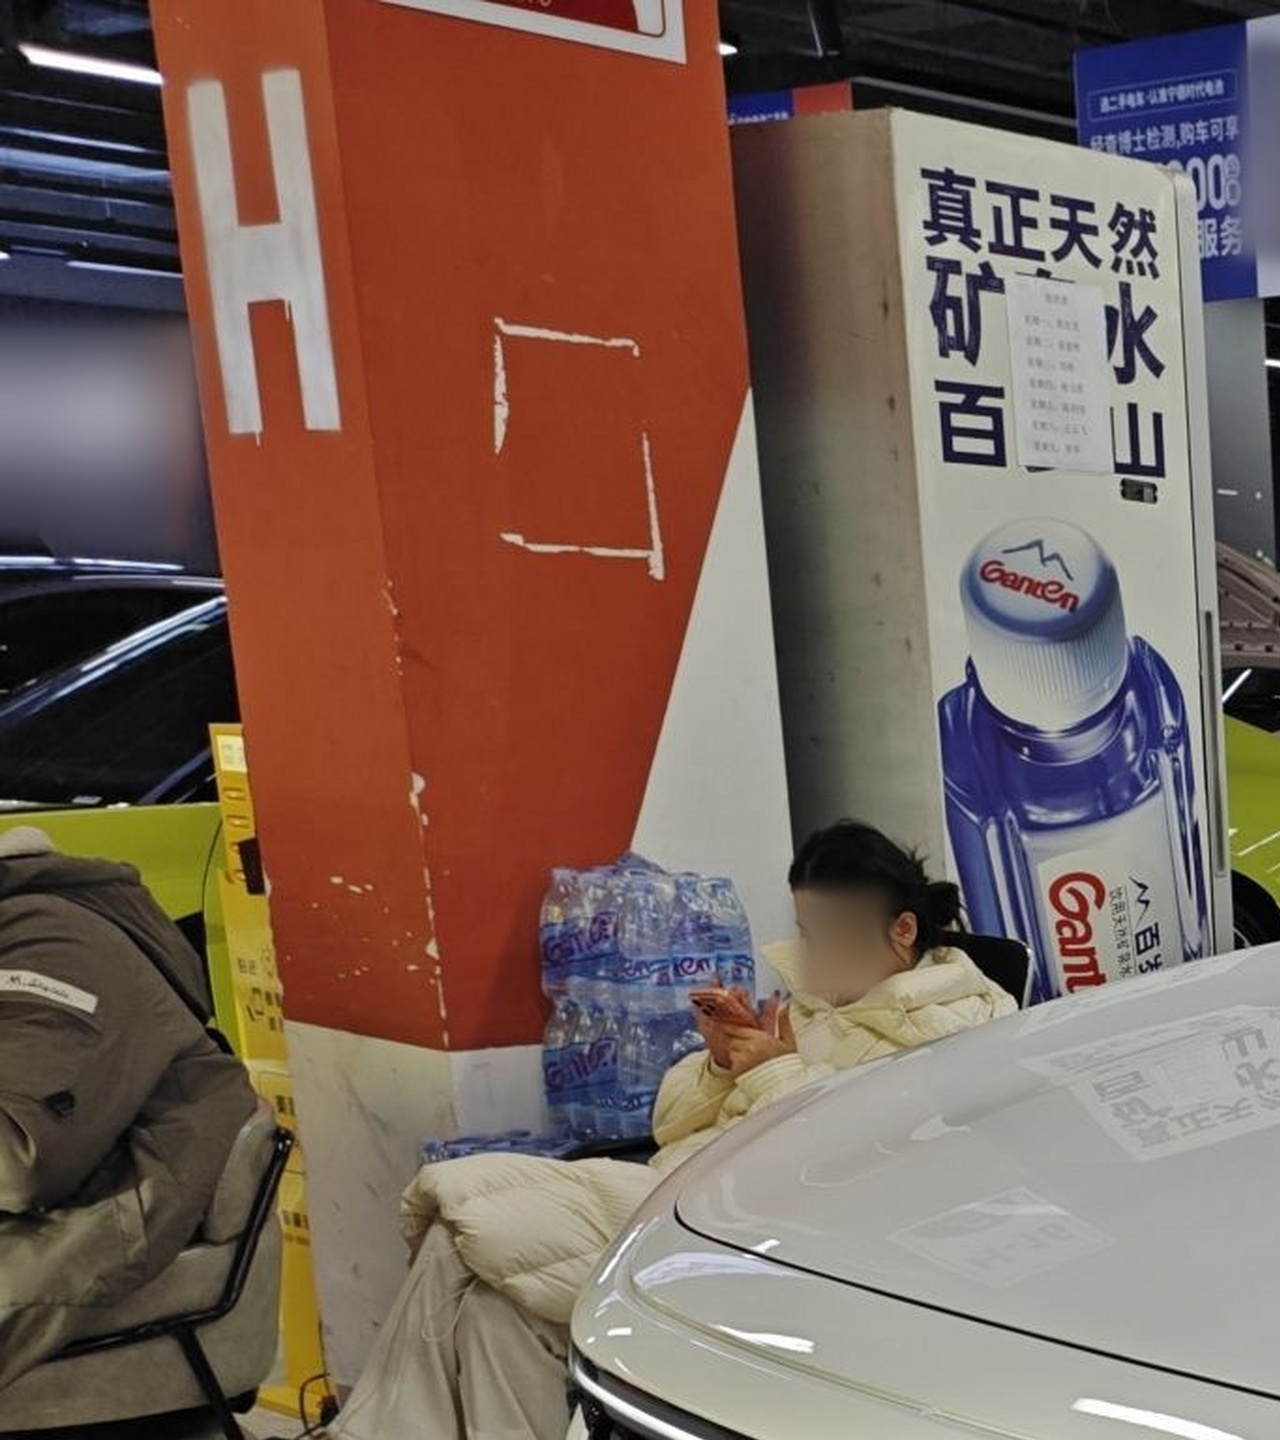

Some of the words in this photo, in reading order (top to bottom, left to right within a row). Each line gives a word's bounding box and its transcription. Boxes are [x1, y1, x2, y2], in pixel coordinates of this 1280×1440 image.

[187, 67, 342, 435] H
[921, 167, 1160, 280] 真正天然
[979, 560, 1080, 613] Ganten
